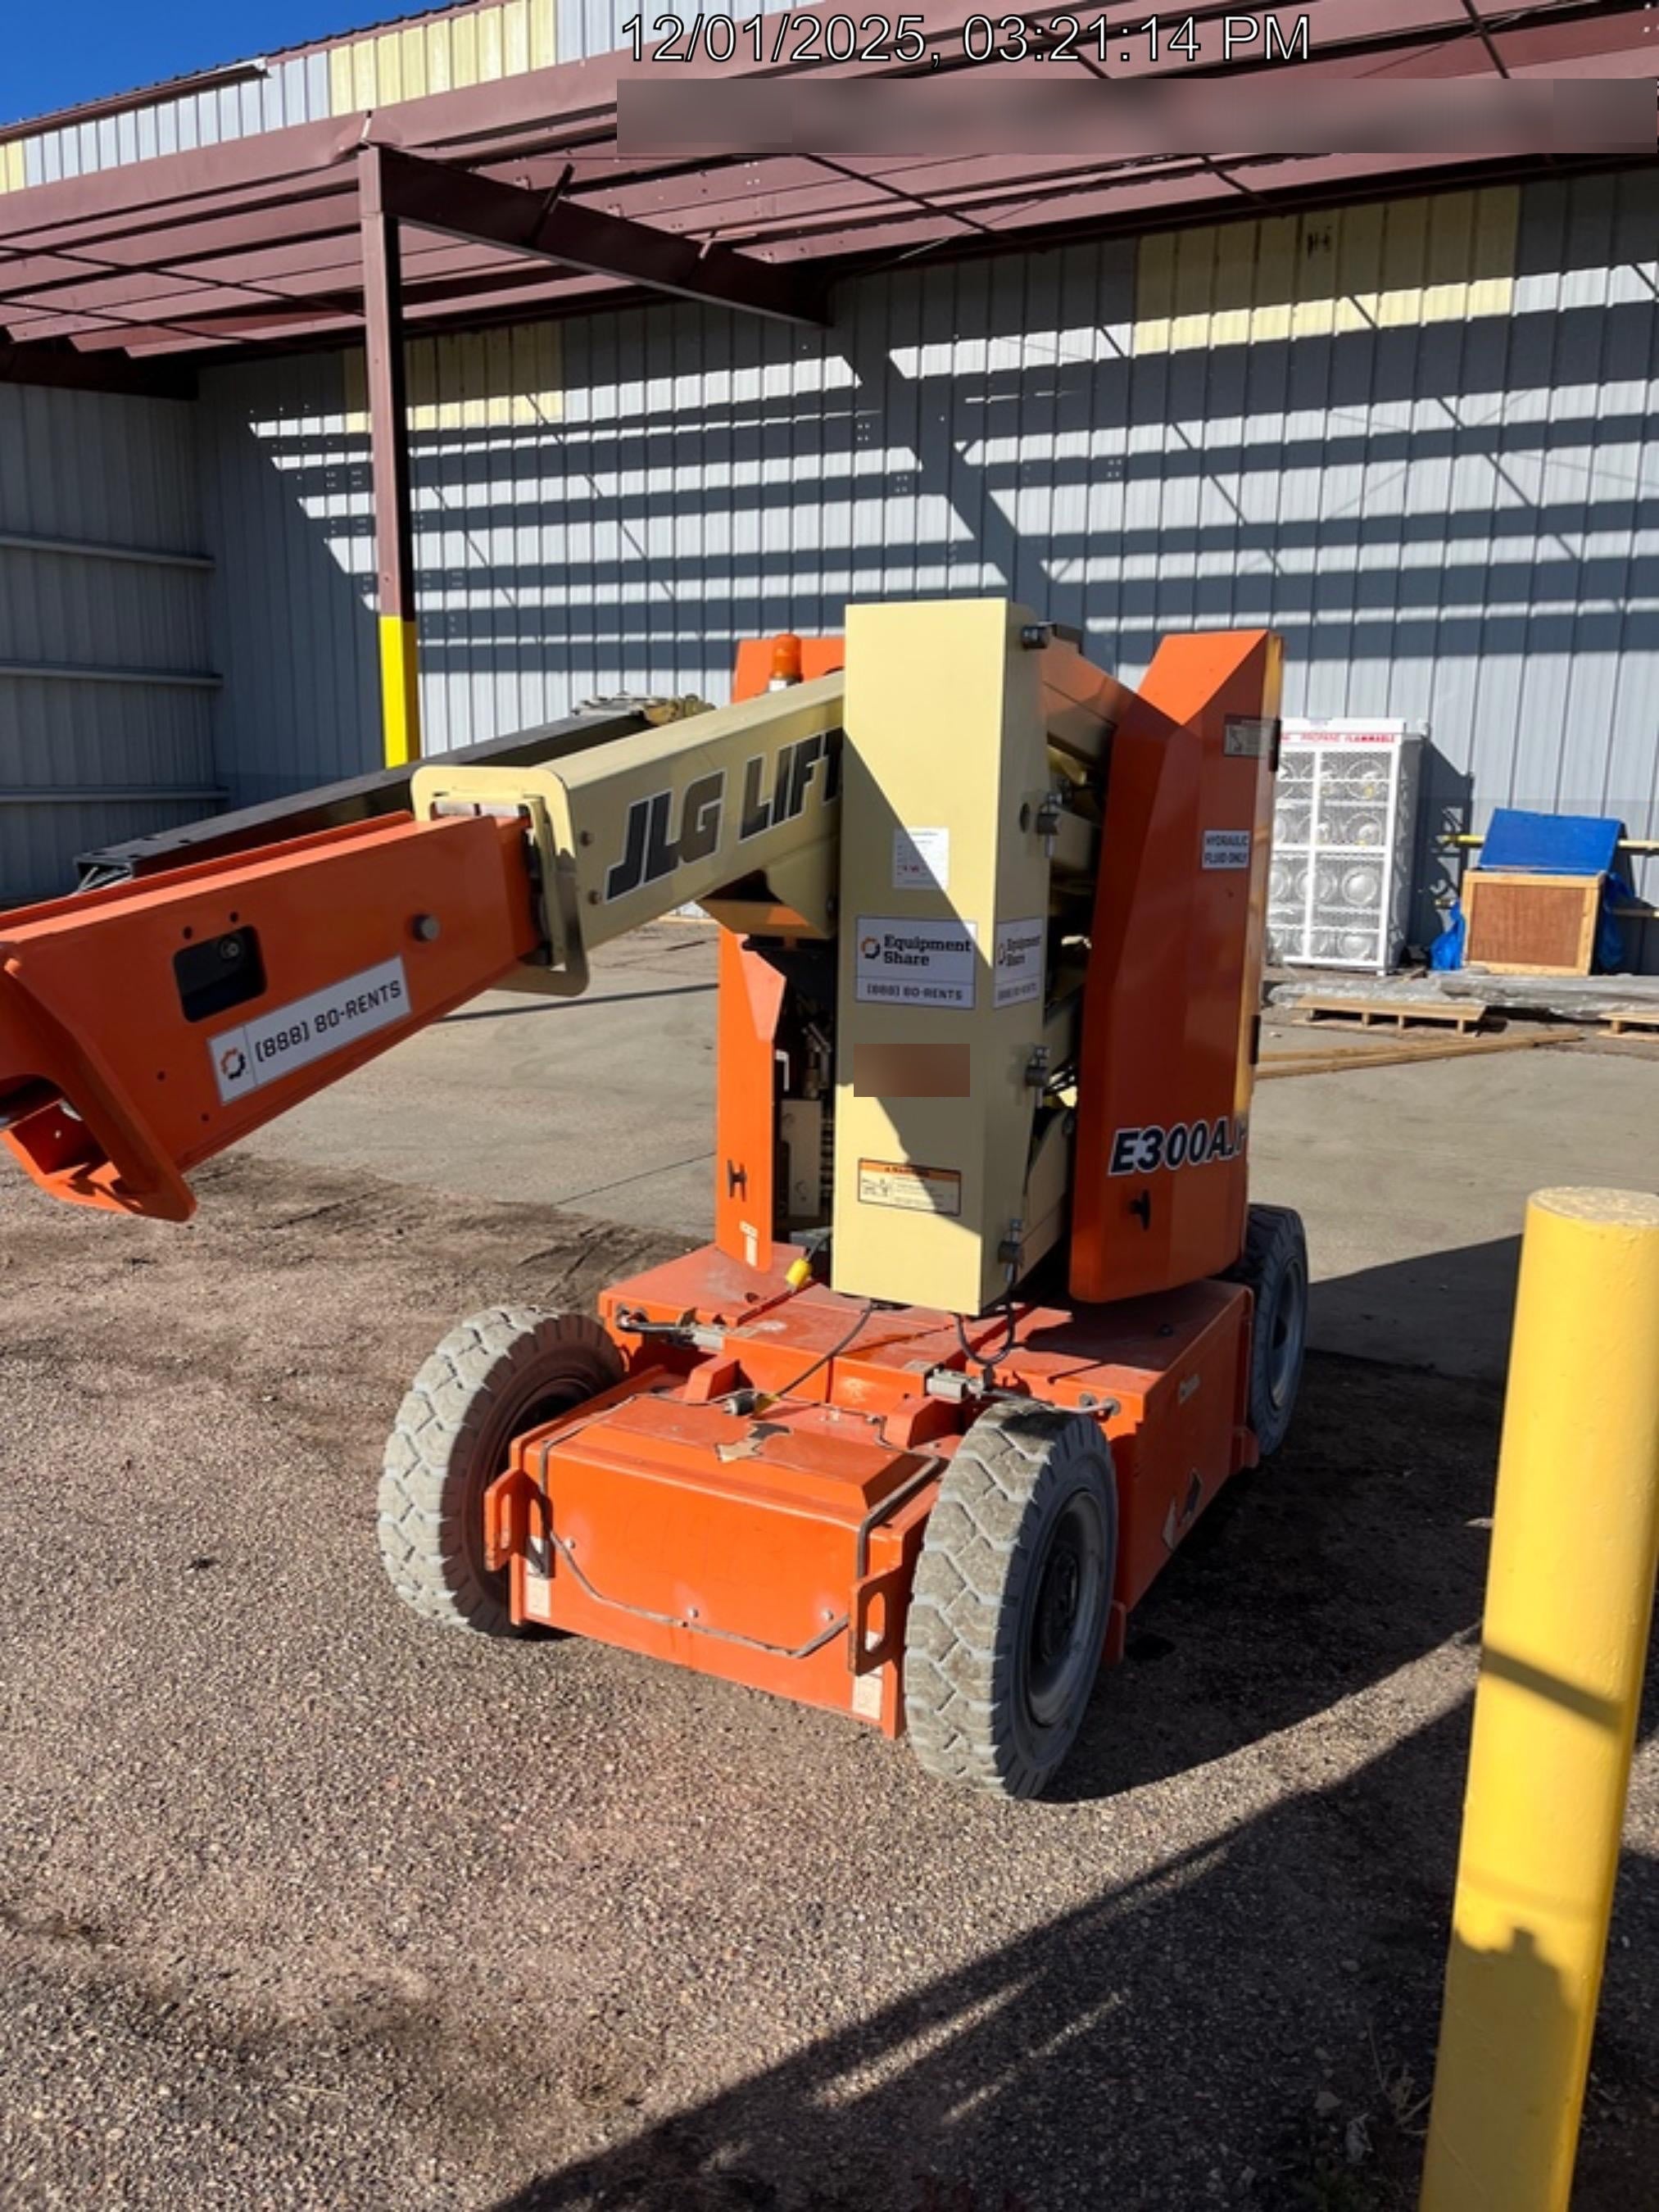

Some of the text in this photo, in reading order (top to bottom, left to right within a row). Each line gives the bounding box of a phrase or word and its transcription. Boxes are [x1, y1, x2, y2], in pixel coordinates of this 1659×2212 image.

[605, 768, 727, 902] JLG
[883, 934, 972, 953] Equipment
[883, 950, 931, 967] Share
[254, 979, 402, 1063] (888) 80-RENTS
